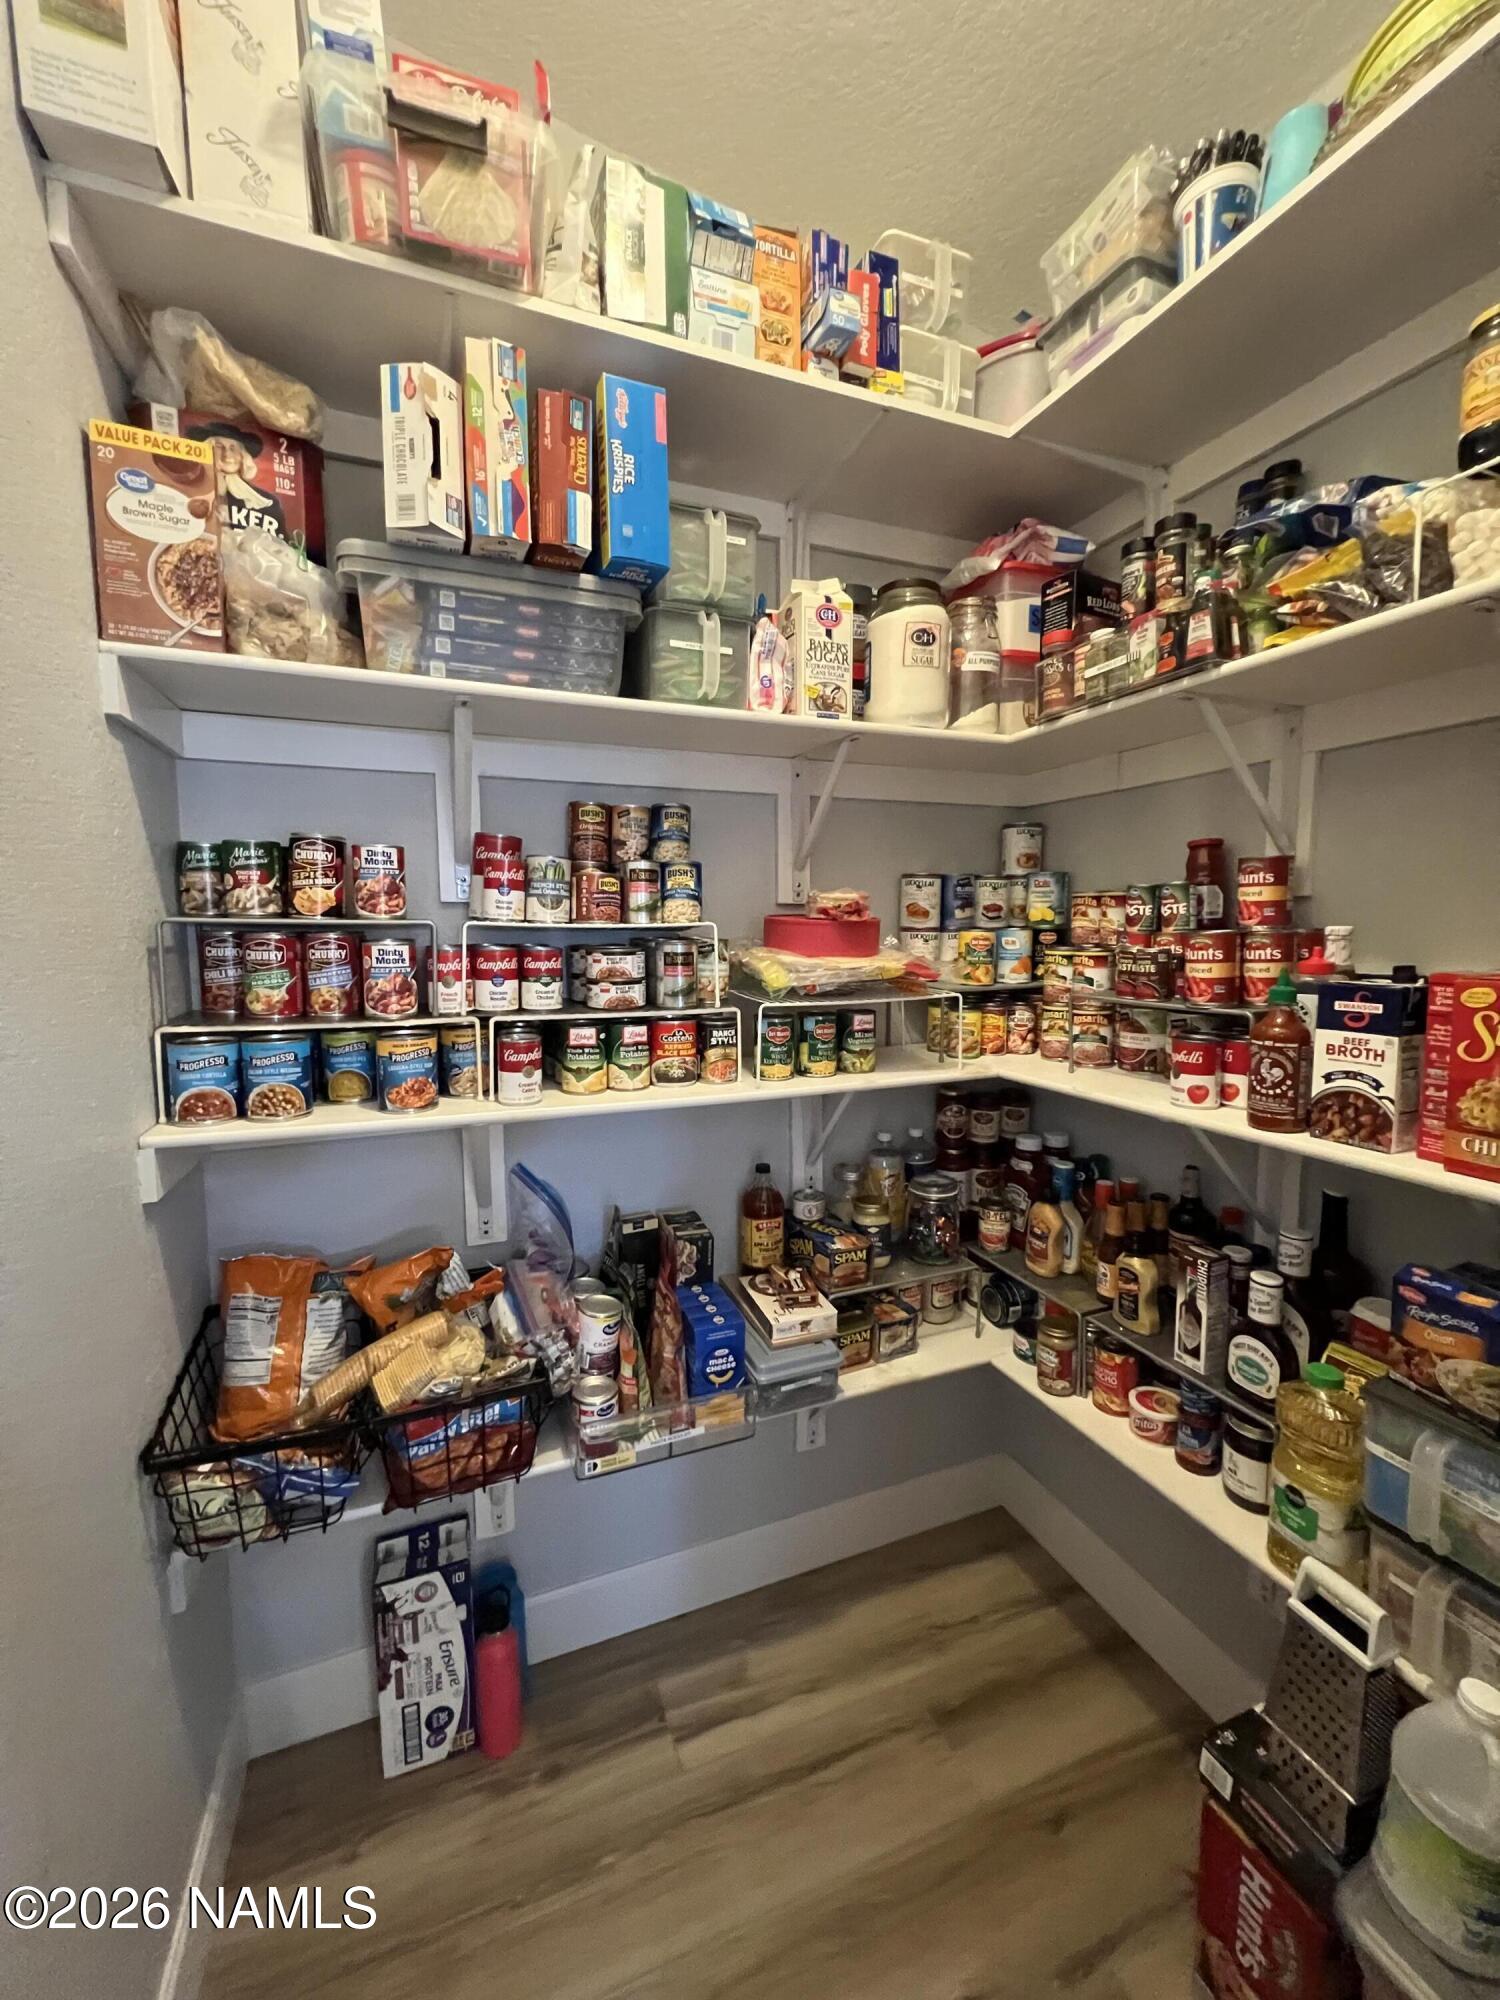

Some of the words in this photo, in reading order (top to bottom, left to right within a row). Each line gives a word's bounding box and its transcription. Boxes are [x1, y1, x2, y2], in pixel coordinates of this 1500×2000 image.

[755, 239, 796, 263] TORTILLA
[860, 282, 871, 327] Gloves
[393, 416, 405, 440] TRIPLE
[94, 423, 139, 445] VALUE
[143, 434, 181, 454] PACK
[279, 437, 288, 454] 2
[96, 445, 115, 459] 20
[395, 443, 408, 485] CHOCOLATE
[573, 435, 588, 486] Cheerios
[609, 438, 626, 495] KRISPIES
[623, 453, 635, 485] RICE
[138, 499, 174, 514] Maple
[122, 505, 156, 519] Brown
[159, 513, 190, 526] Sugar
[231, 505, 285, 538] KER.
[1103, 599, 1121, 612] LOBS
[809, 637, 849, 652] BAKER'S
[805, 650, 850, 666] SUGAR
[911, 655, 934, 666] SUGAR
[580, 809, 604, 819] BUSH'S
[664, 810, 689, 822] BUSH'S
[231, 847, 265, 859] Marie
[294, 849, 333, 862] CHUNKY
[366, 849, 392, 859] Dinty
[364, 857, 394, 866] Moore
[292, 870, 335, 879] SPICY
[667, 869, 695, 879] BUSH'S
[245, 949, 284, 961] CHUNKY
[309, 949, 347, 960] CHUNKY
[377, 948, 404, 957] Dinty
[375, 956, 407, 966] Moore
[227, 968, 243, 977] MA
[1336, 1002, 1381, 1013] SWANSON
[329, 1042, 366, 1055] PROGRESSO
[1343, 1036, 1371, 1047] BEEF
[251, 1052, 295, 1068] PROGRESSO
[391, 1048, 430, 1063] PROGRESSO
[1325, 1043, 1385, 1062] BROTH
[179, 1055, 226, 1072] PROGRESSO
[834, 1249, 867, 1265] SPAM
[839, 1330, 871, 1347] SPAM
[1424, 1329, 1456, 1346] Onion
[418, 1531, 431, 1550] 12
[439, 1640, 460, 1687] Ensure
[423, 1656, 434, 1697] PROTEIN
